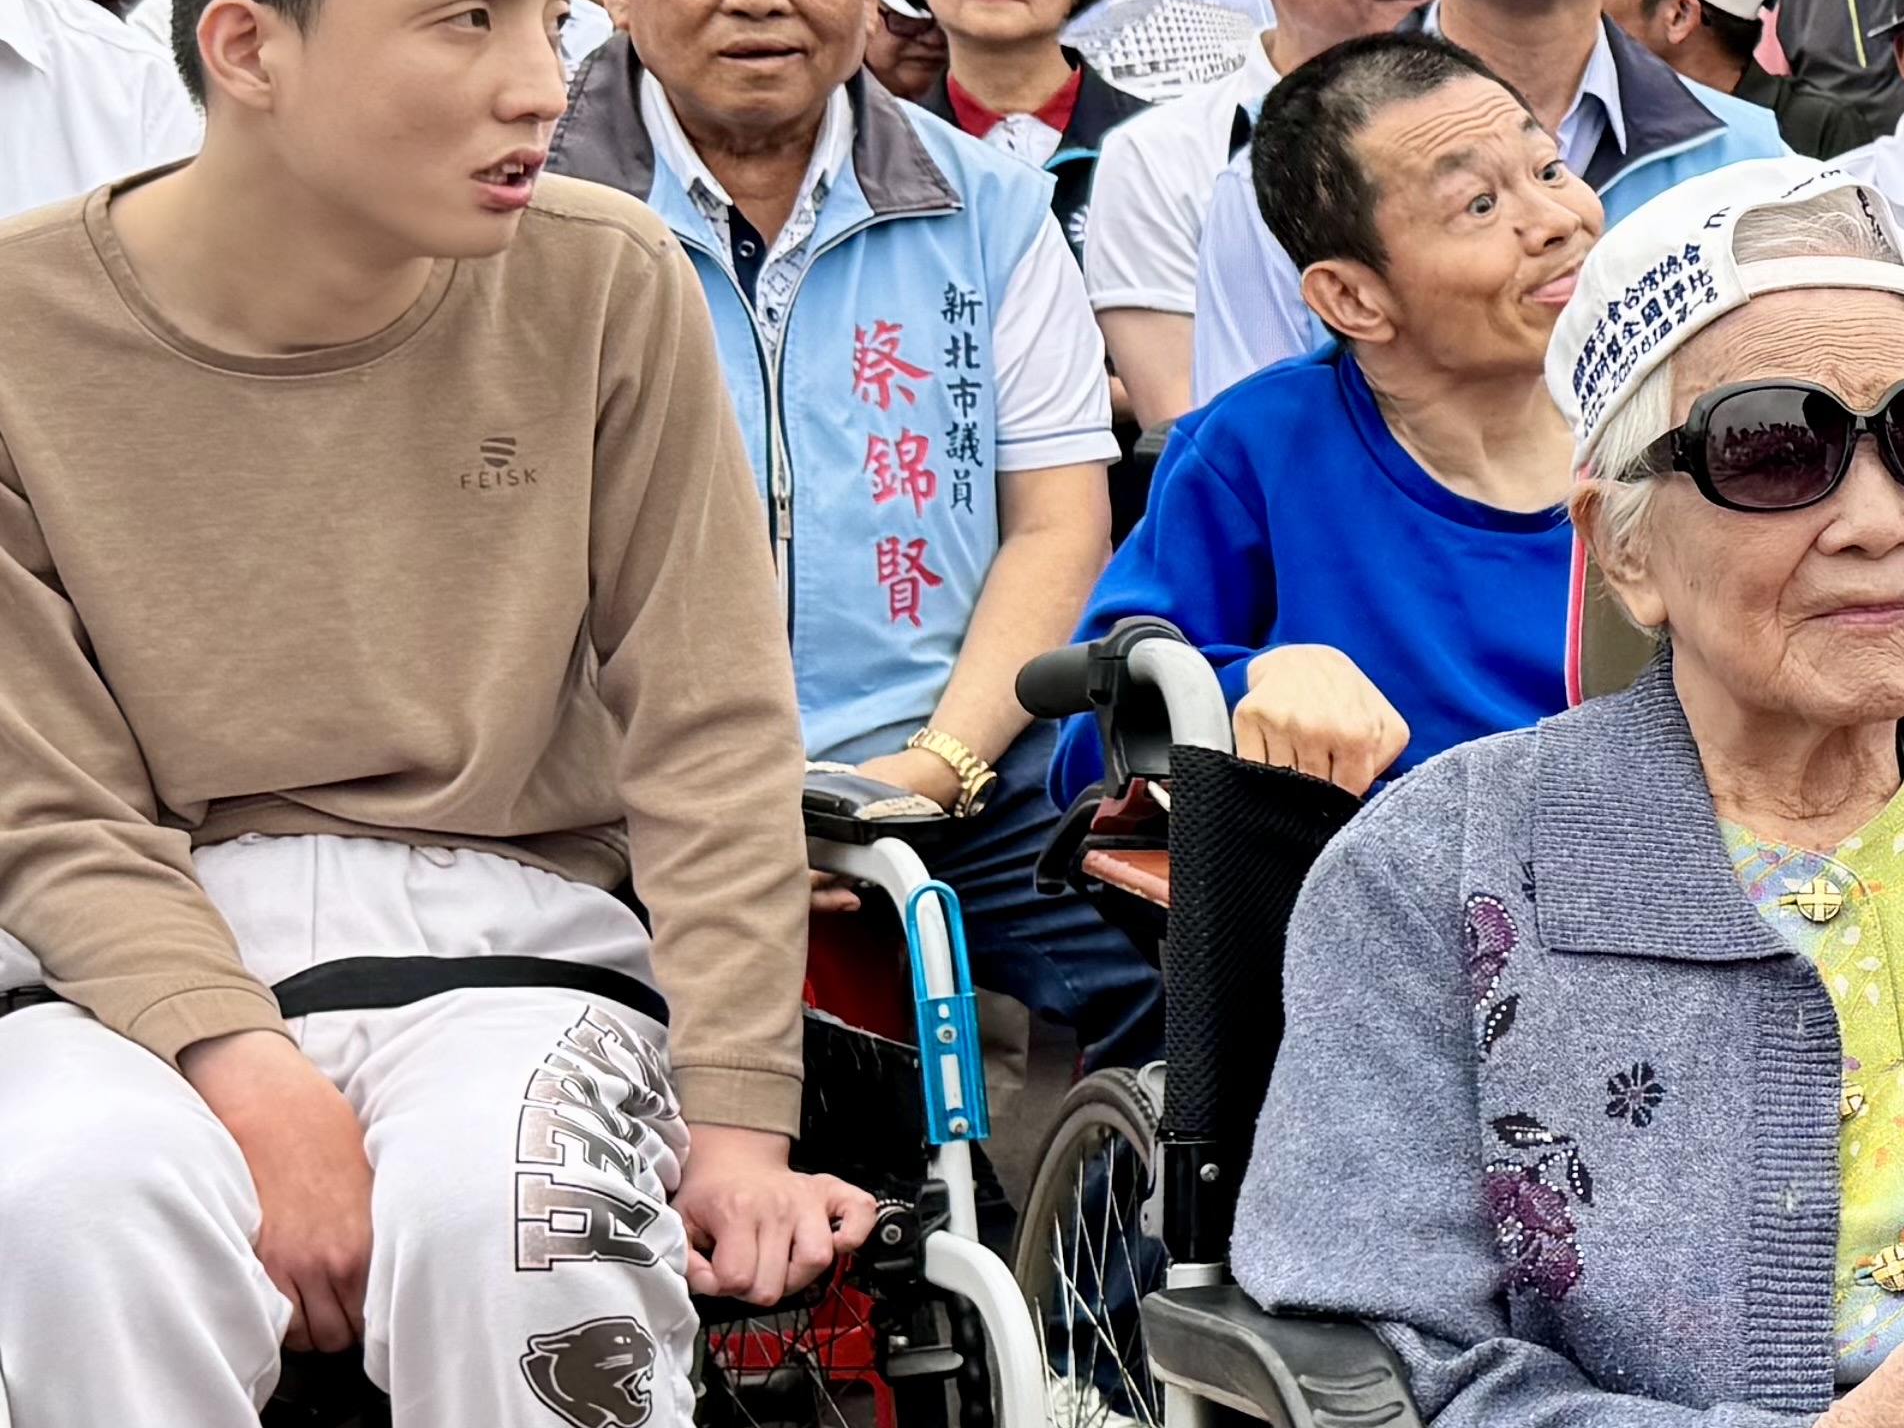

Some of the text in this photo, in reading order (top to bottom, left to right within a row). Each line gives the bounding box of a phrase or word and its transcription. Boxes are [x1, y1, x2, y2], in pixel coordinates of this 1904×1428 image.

[460, 468, 537, 490] FEISK
[851, 319, 944, 629] 蔡錦賢
[940, 281, 984, 515] 新北市議員
